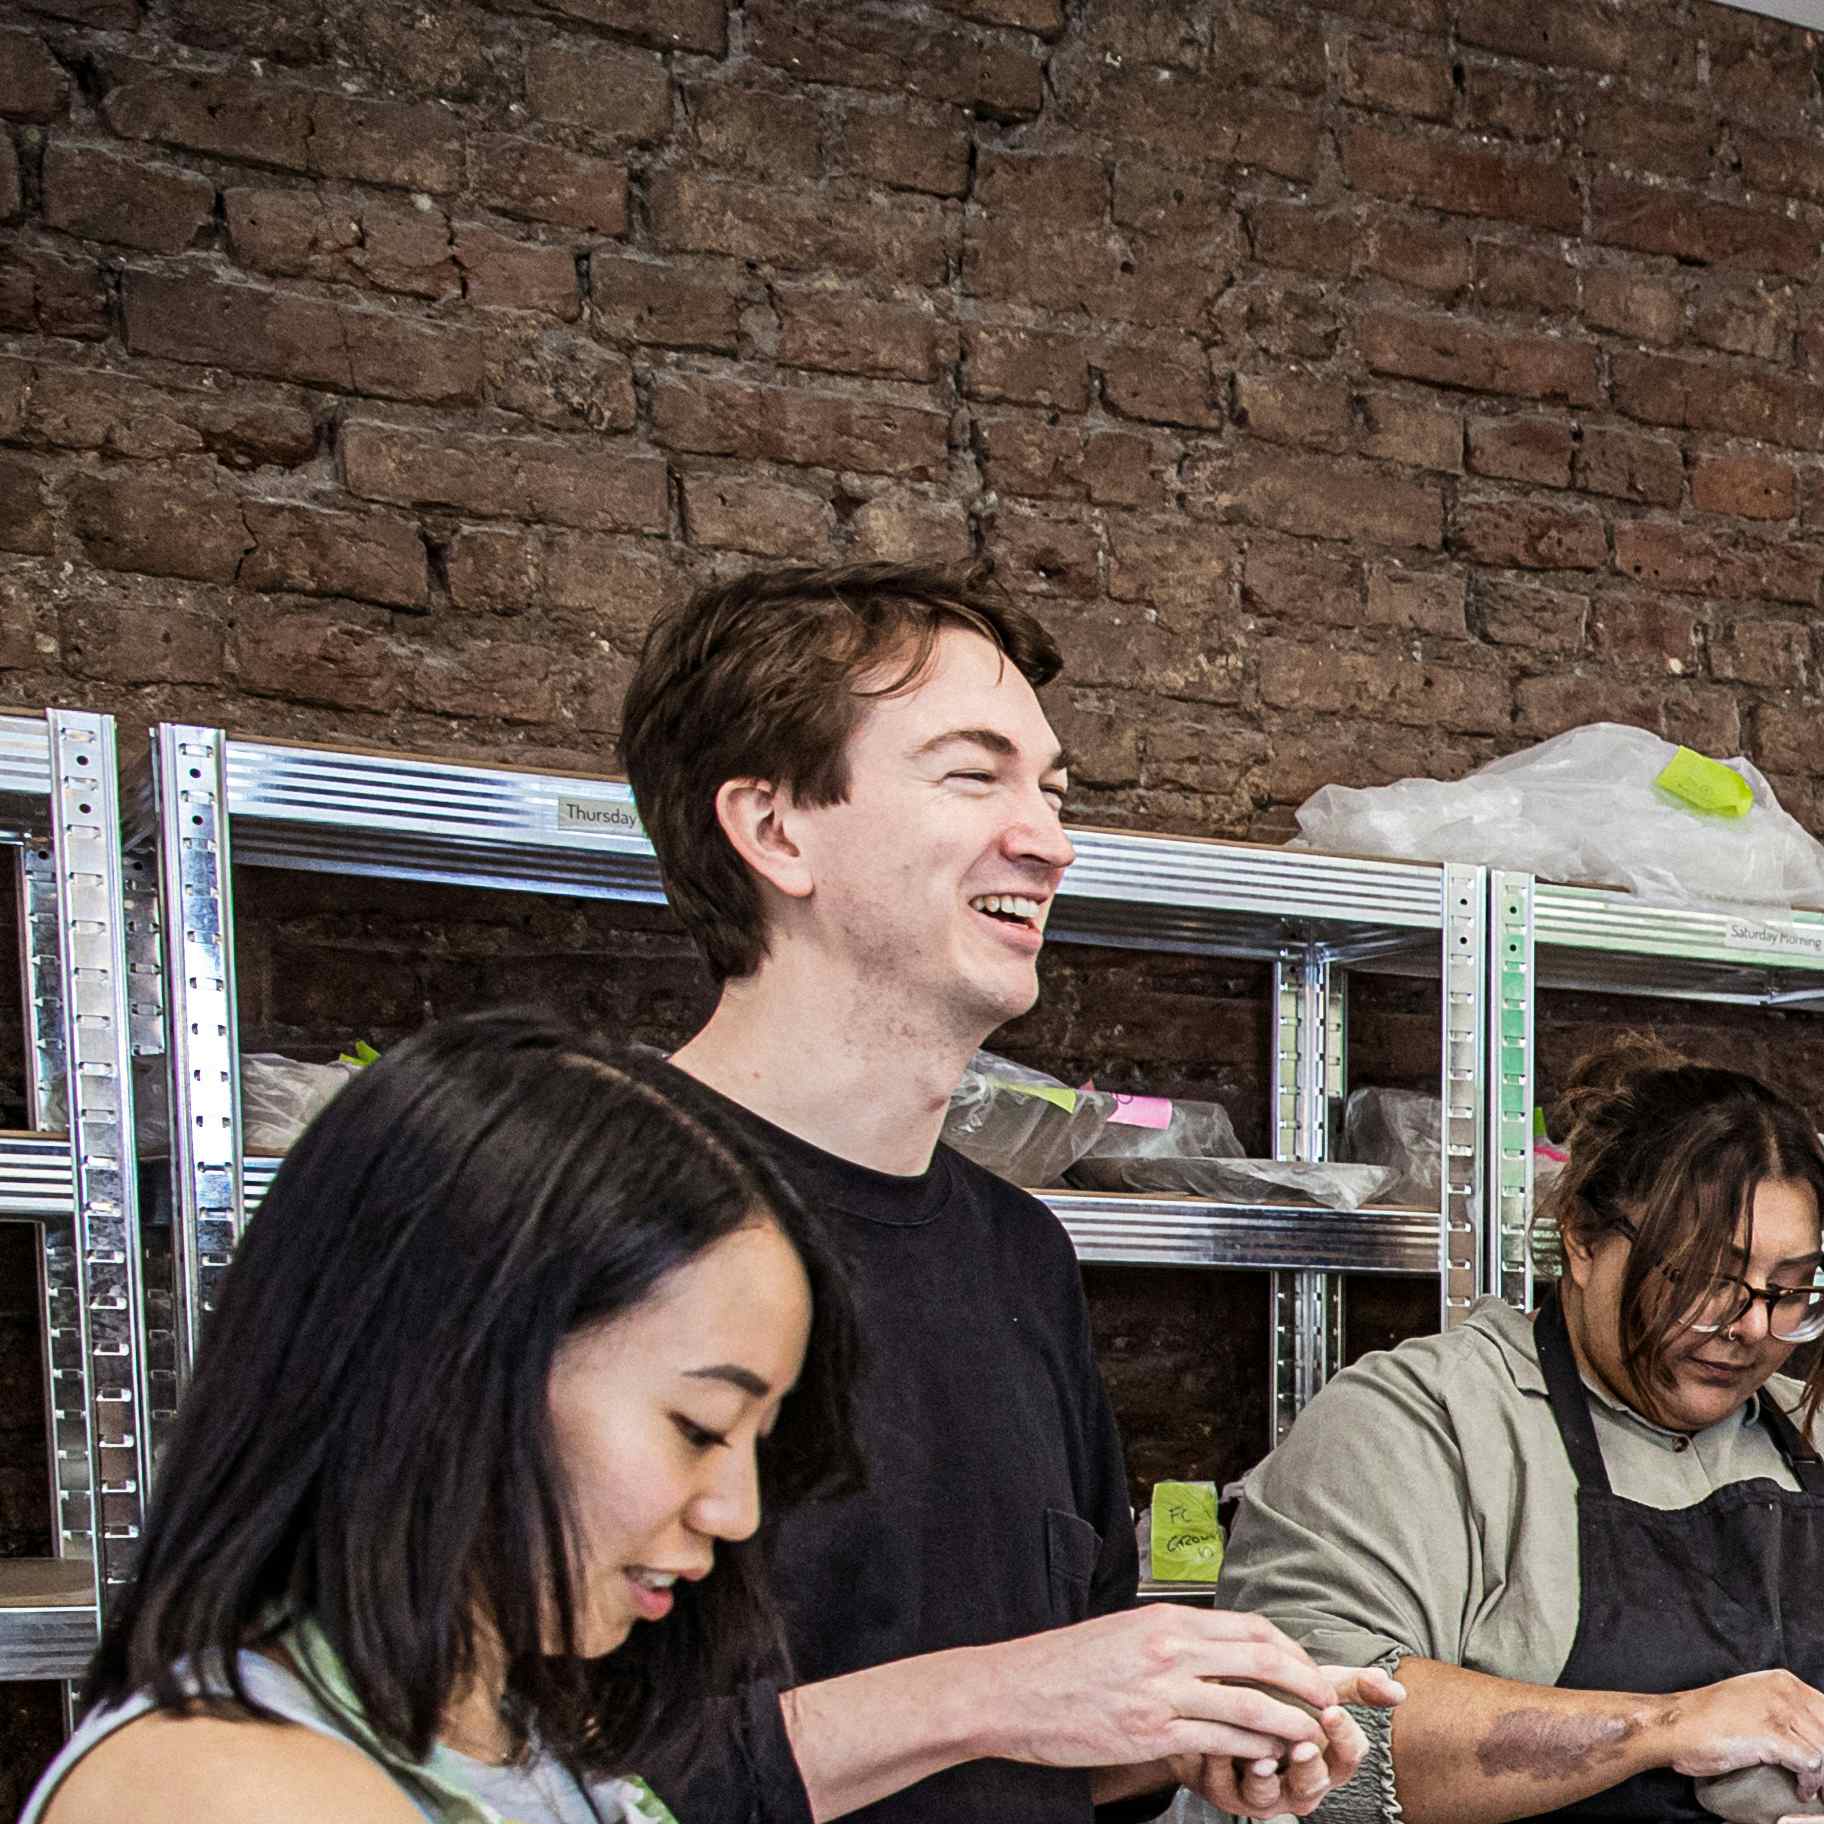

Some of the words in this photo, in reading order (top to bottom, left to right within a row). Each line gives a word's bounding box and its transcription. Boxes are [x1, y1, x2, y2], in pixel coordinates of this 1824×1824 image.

[566, 803, 637, 828] Thursday
[1731, 924, 1778, 945] Saturday
[1780, 932, 1822, 951] Morning
